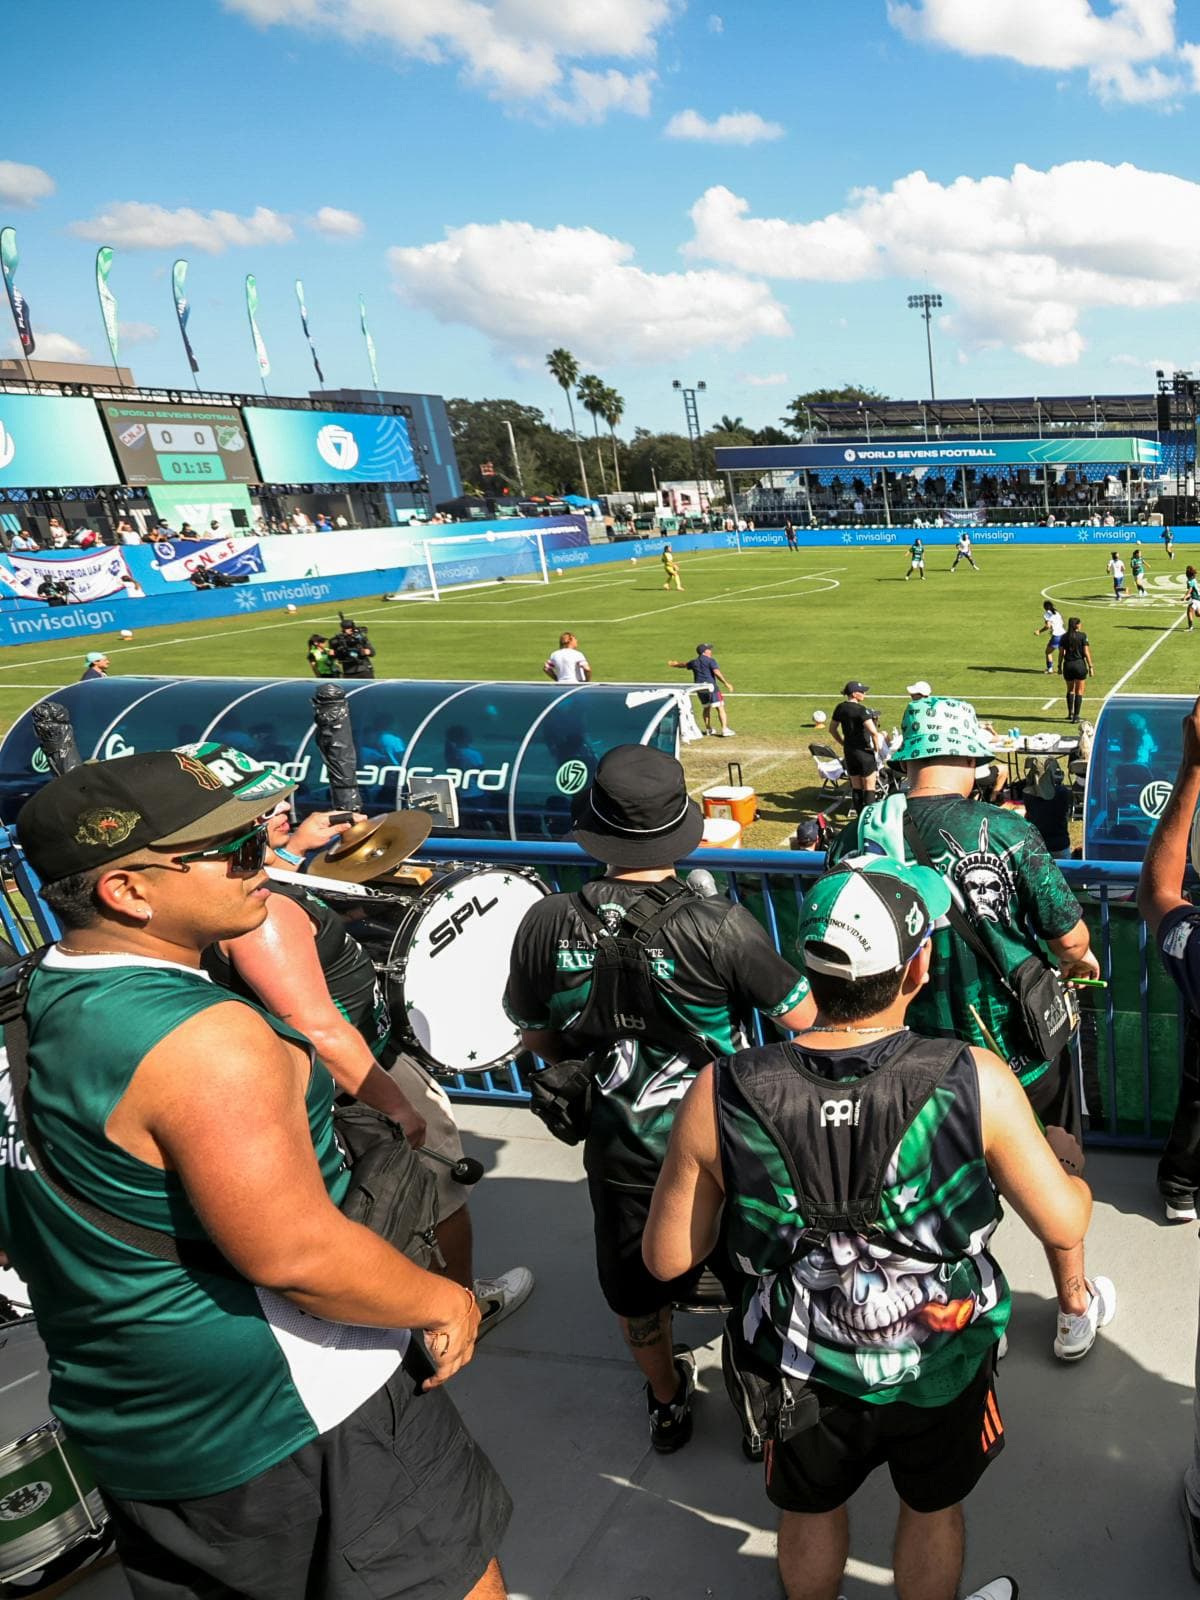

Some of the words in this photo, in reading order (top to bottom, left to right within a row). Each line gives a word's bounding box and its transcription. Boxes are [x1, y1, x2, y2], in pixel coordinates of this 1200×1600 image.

[119, 408, 155, 418] WORLD
[156, 410, 192, 419] SEVENS
[193, 412, 238, 421] FOOTBALL
[161, 430, 172, 444] 0
[194, 431, 205, 445] 0
[857, 450, 896, 459] WORLD
[897, 450, 938, 458] SEVENS
[939, 449, 996, 457] FOOTBALL
[171, 461, 212, 474] 01:15
[742, 533, 784, 545] invisalign
[855, 532, 897, 544] invisalign
[972, 530, 1015, 542] invisalign
[1093, 528, 1136, 541] invisalign
[551, 550, 589, 563] invisalign
[260, 583, 331, 602] invisalign
[9, 609, 115, 634] invisalign
[429, 896, 499, 959] SPL
